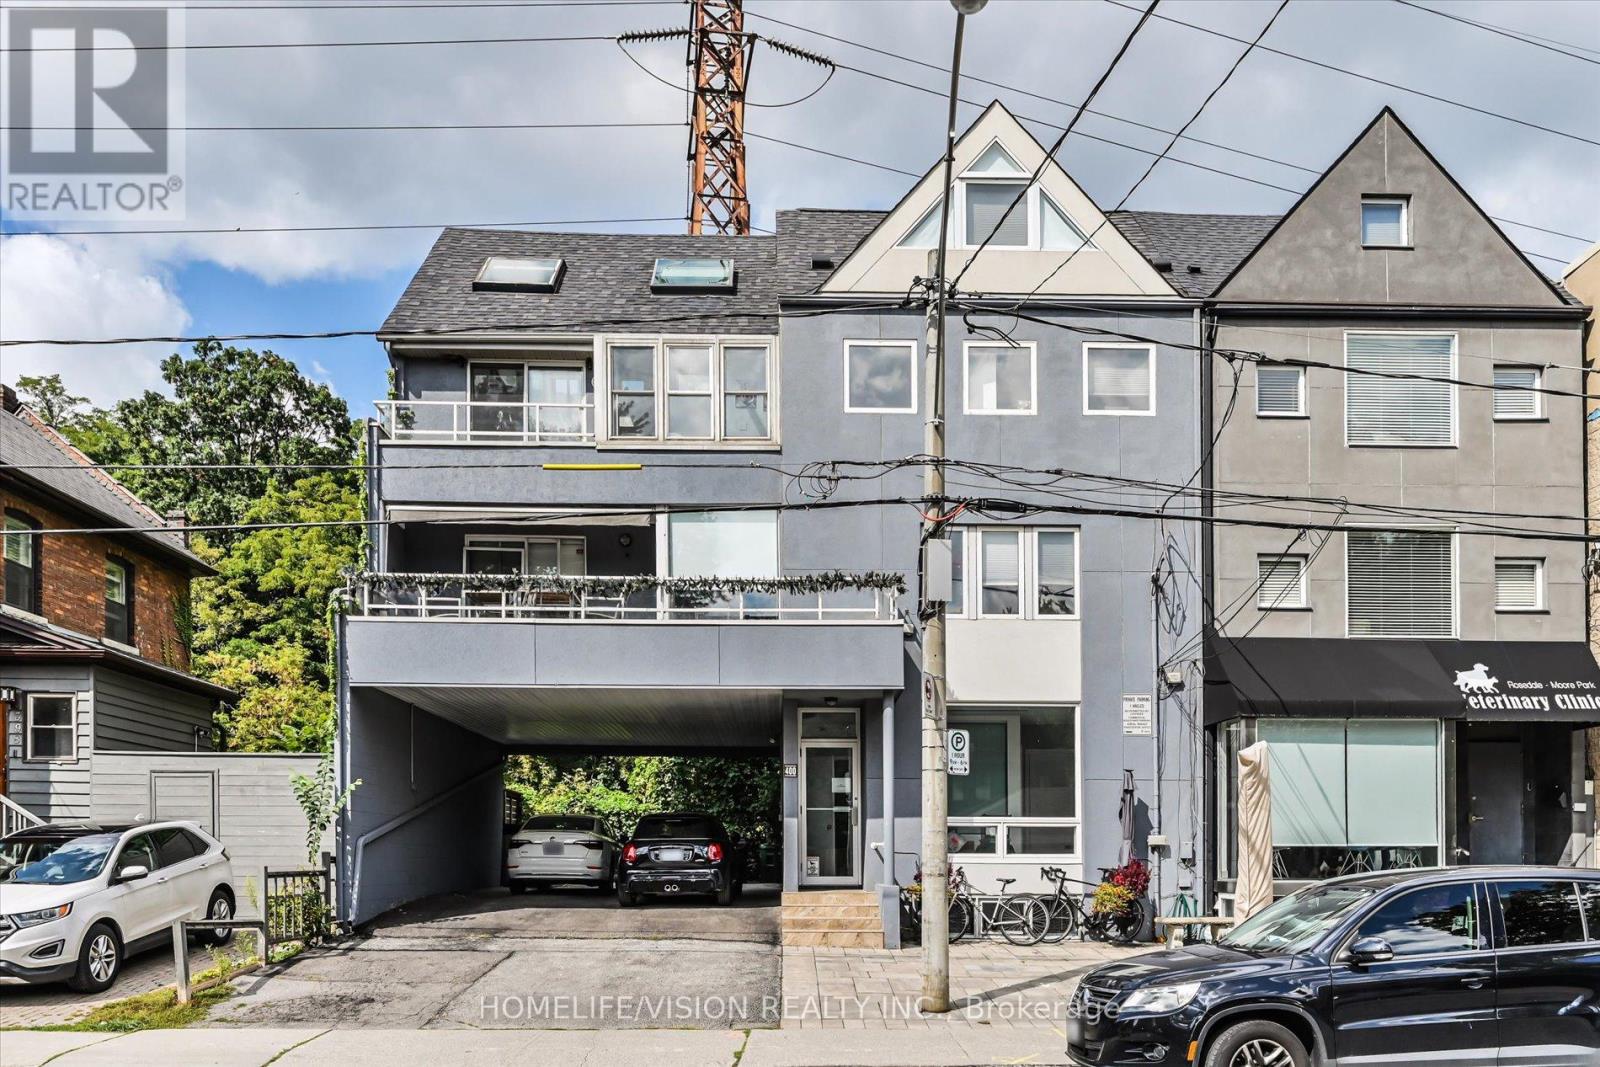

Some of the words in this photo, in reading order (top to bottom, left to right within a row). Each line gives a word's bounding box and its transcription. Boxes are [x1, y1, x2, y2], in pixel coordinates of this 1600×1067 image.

[1506, 680, 1543, 690] Rosedale
[1550, 681, 1575, 689] Moore
[1576, 681, 1596, 689] Park
[1462, 693, 1550, 711] eterinary
[955, 736, 963, 747] P
[784, 767, 797, 775] 400
